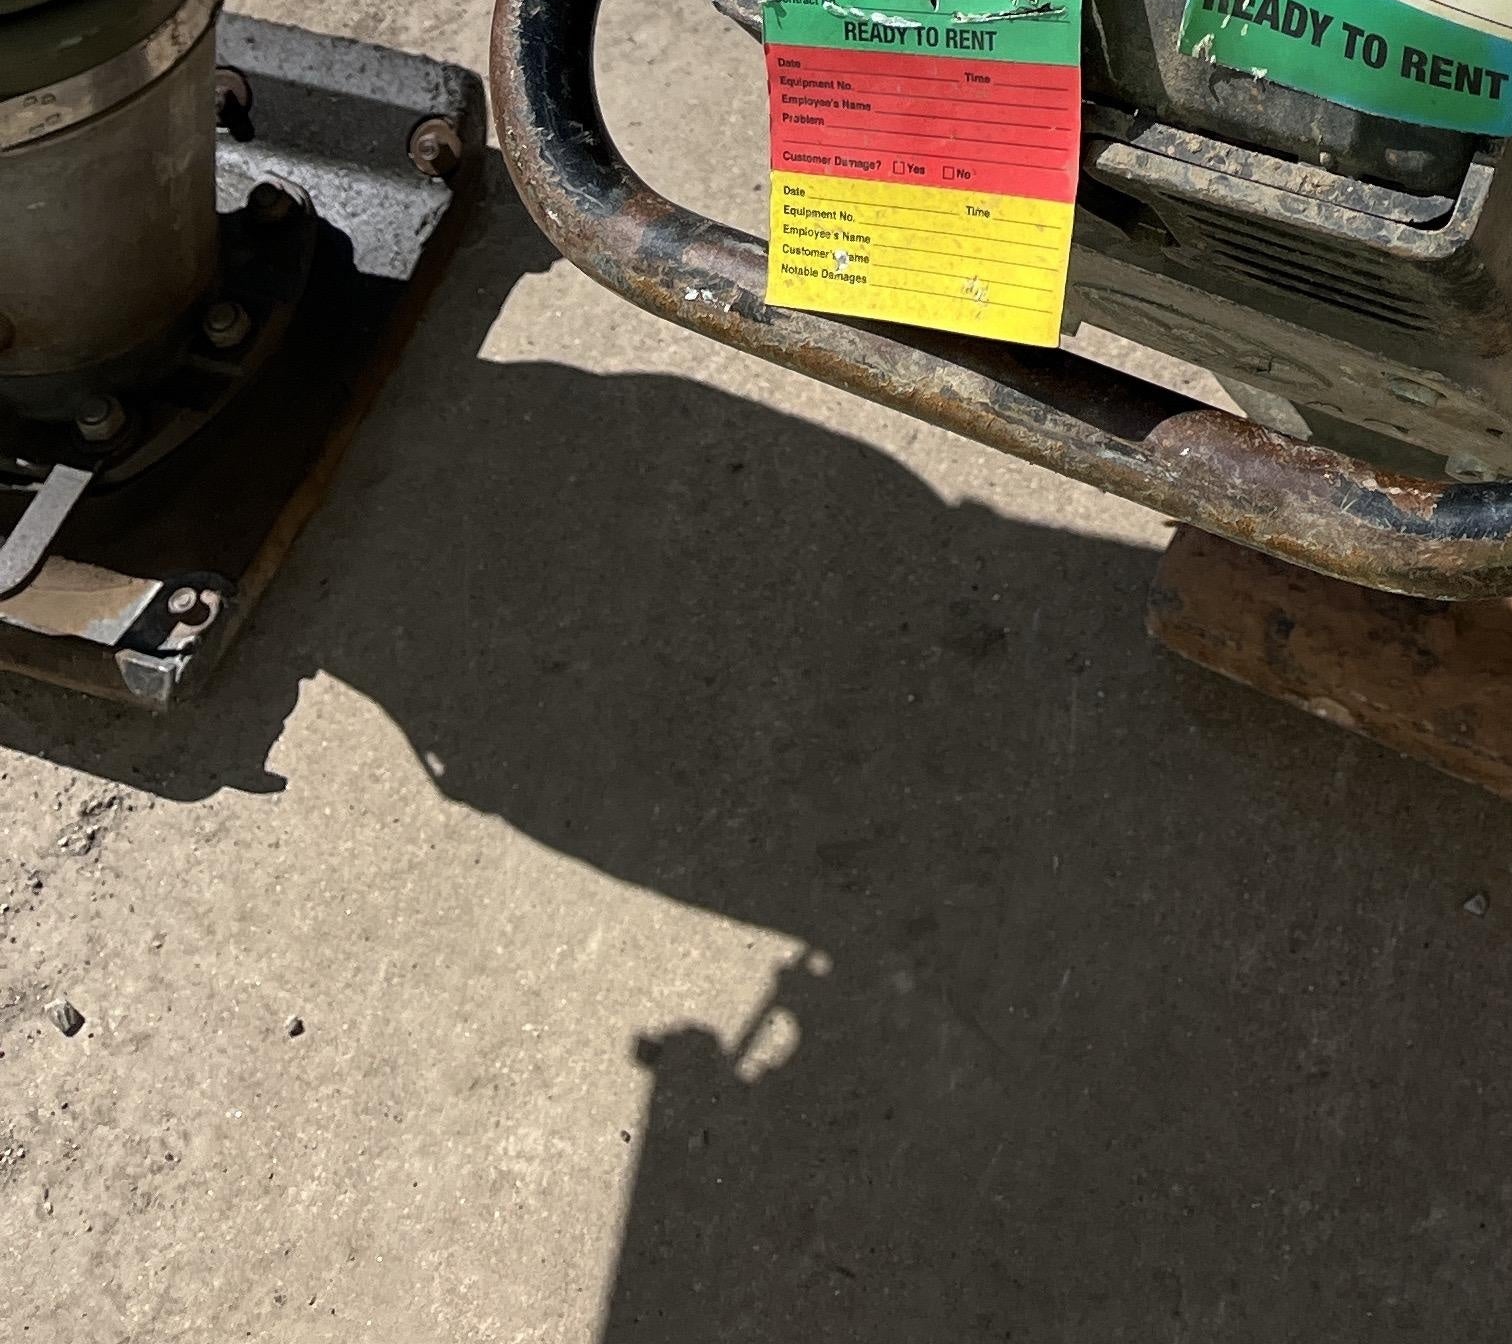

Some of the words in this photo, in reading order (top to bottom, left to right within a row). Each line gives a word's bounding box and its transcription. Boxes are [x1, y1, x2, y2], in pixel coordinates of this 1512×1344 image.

[845, 21, 907, 43] READY
[916, 27, 938, 46] TO
[946, 28, 997, 51] RENT
[778, 58, 801, 68] Date
[1340, 20, 1388, 69] TO
[1401, 45, 1510, 101] RENT
[779, 76, 834, 89] Equipment
[965, 72, 990, 83] Time
[782, 95, 839, 108] Employee's
[842, 101, 871, 111] Name
[782, 113, 824, 125] Problem
[783, 151, 831, 165] Customer
[834, 156, 881, 170] Damage?
[908, 163, 925, 175] Yes
[957, 169, 971, 179] No
[783, 186, 805, 197] Date
[783, 205, 836, 220] Equipment
[840, 211, 855, 222] No.
[966, 206, 990, 218] Time
[783, 224, 839, 239] Employee's
[843, 231, 871, 243] Name
[781, 263, 818, 277] Notable
[821, 268, 867, 284] Damages
